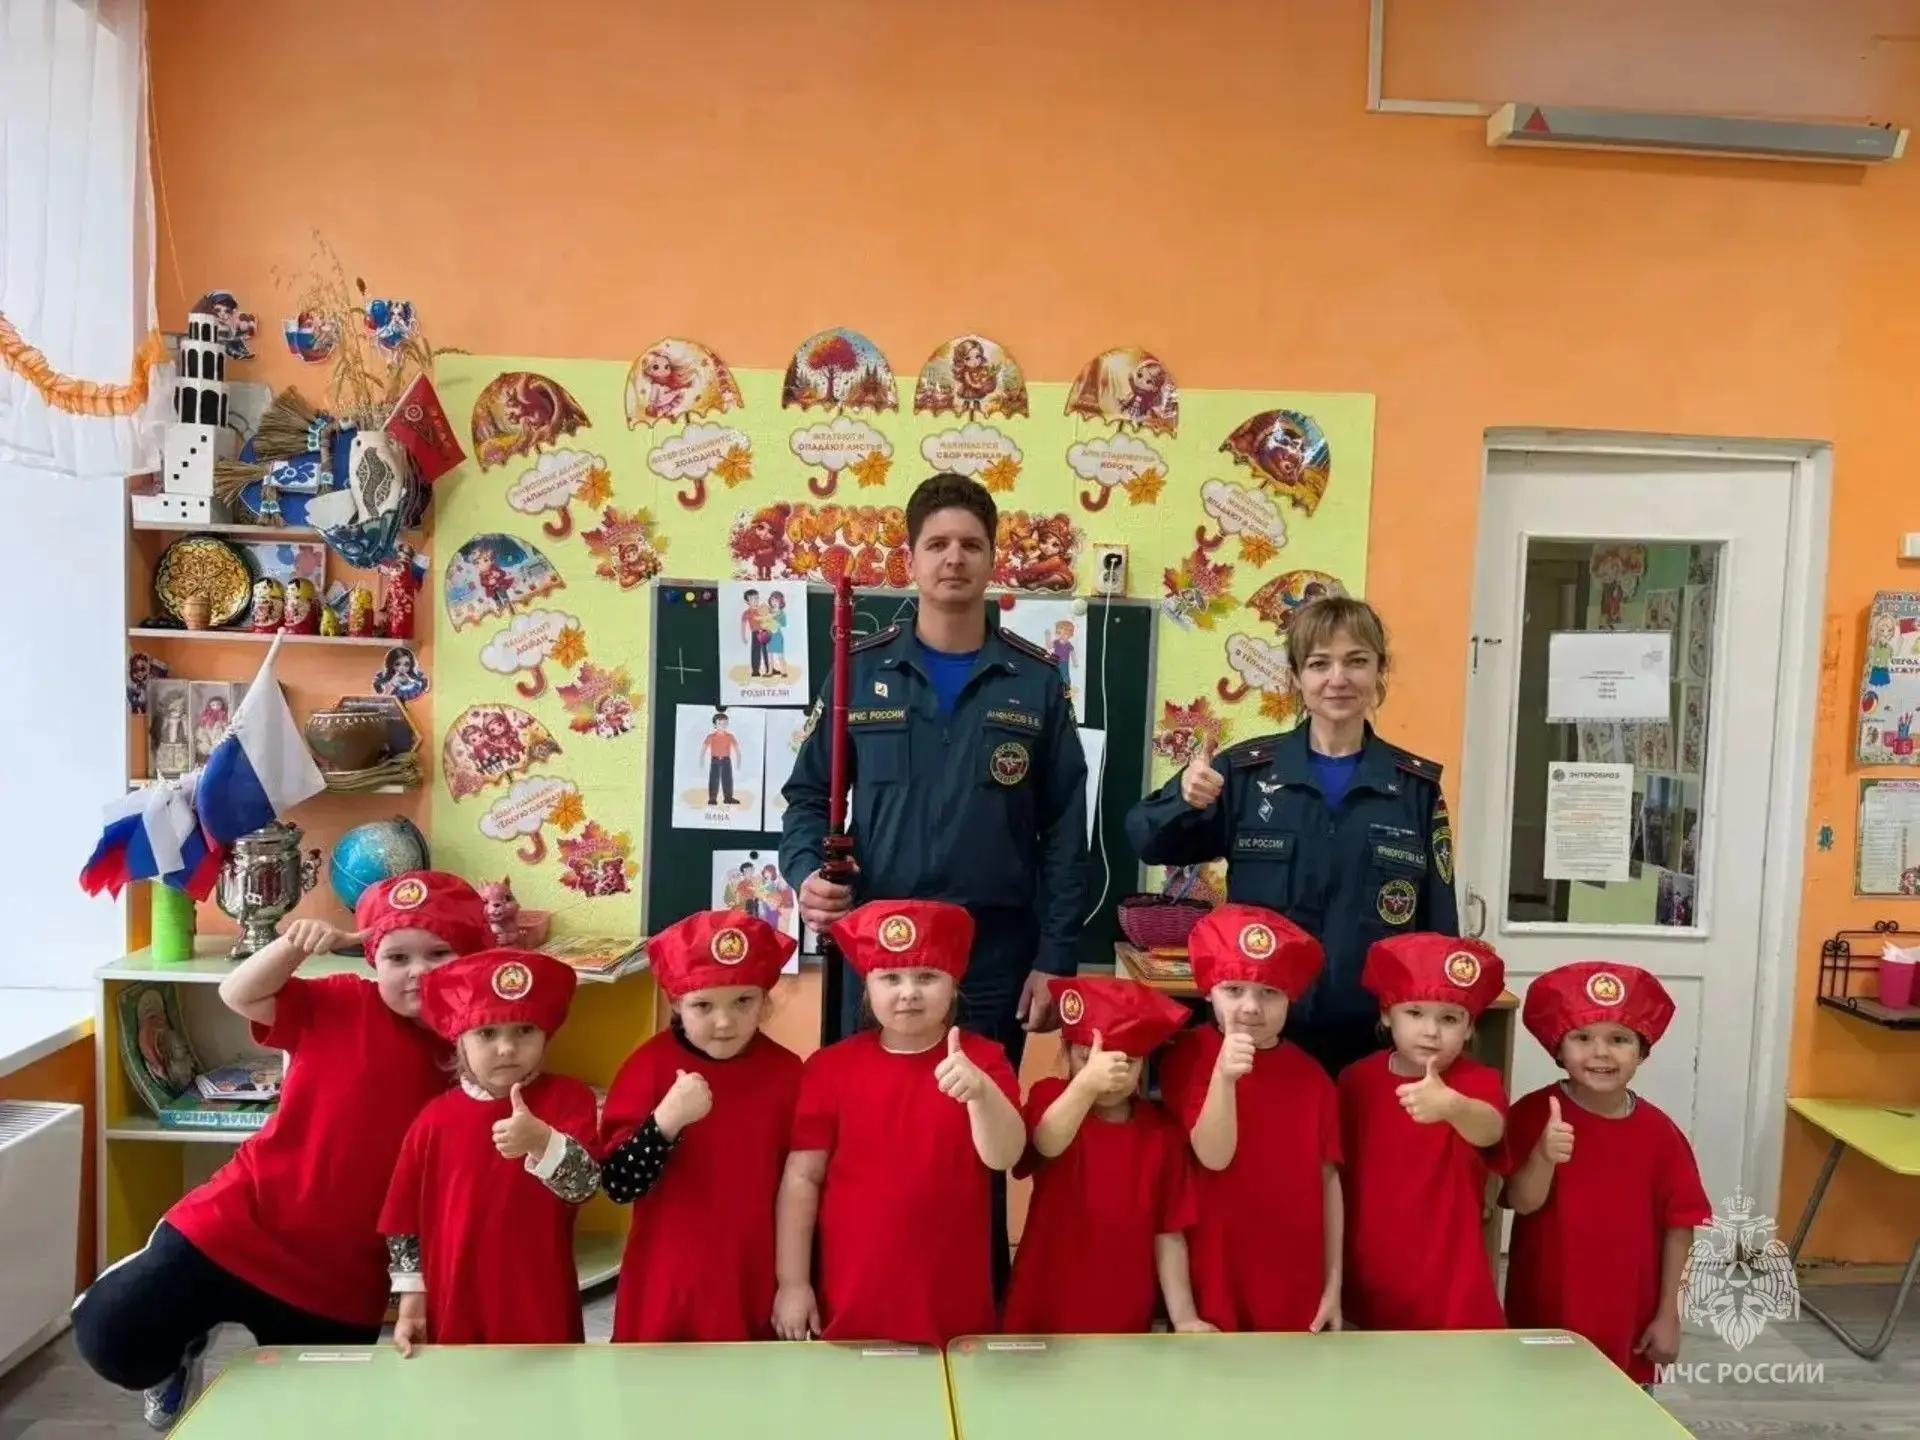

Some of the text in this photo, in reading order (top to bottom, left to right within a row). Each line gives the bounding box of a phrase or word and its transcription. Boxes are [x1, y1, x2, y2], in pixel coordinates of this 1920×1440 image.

[740, 689, 790, 698] РОДИТЕЛИ
[870, 709, 905, 721] РОССИИ
[1568, 771, 1620, 779] ЭНТЕРОБИОЗ
[1252, 838, 1285, 849] РОССИИ
